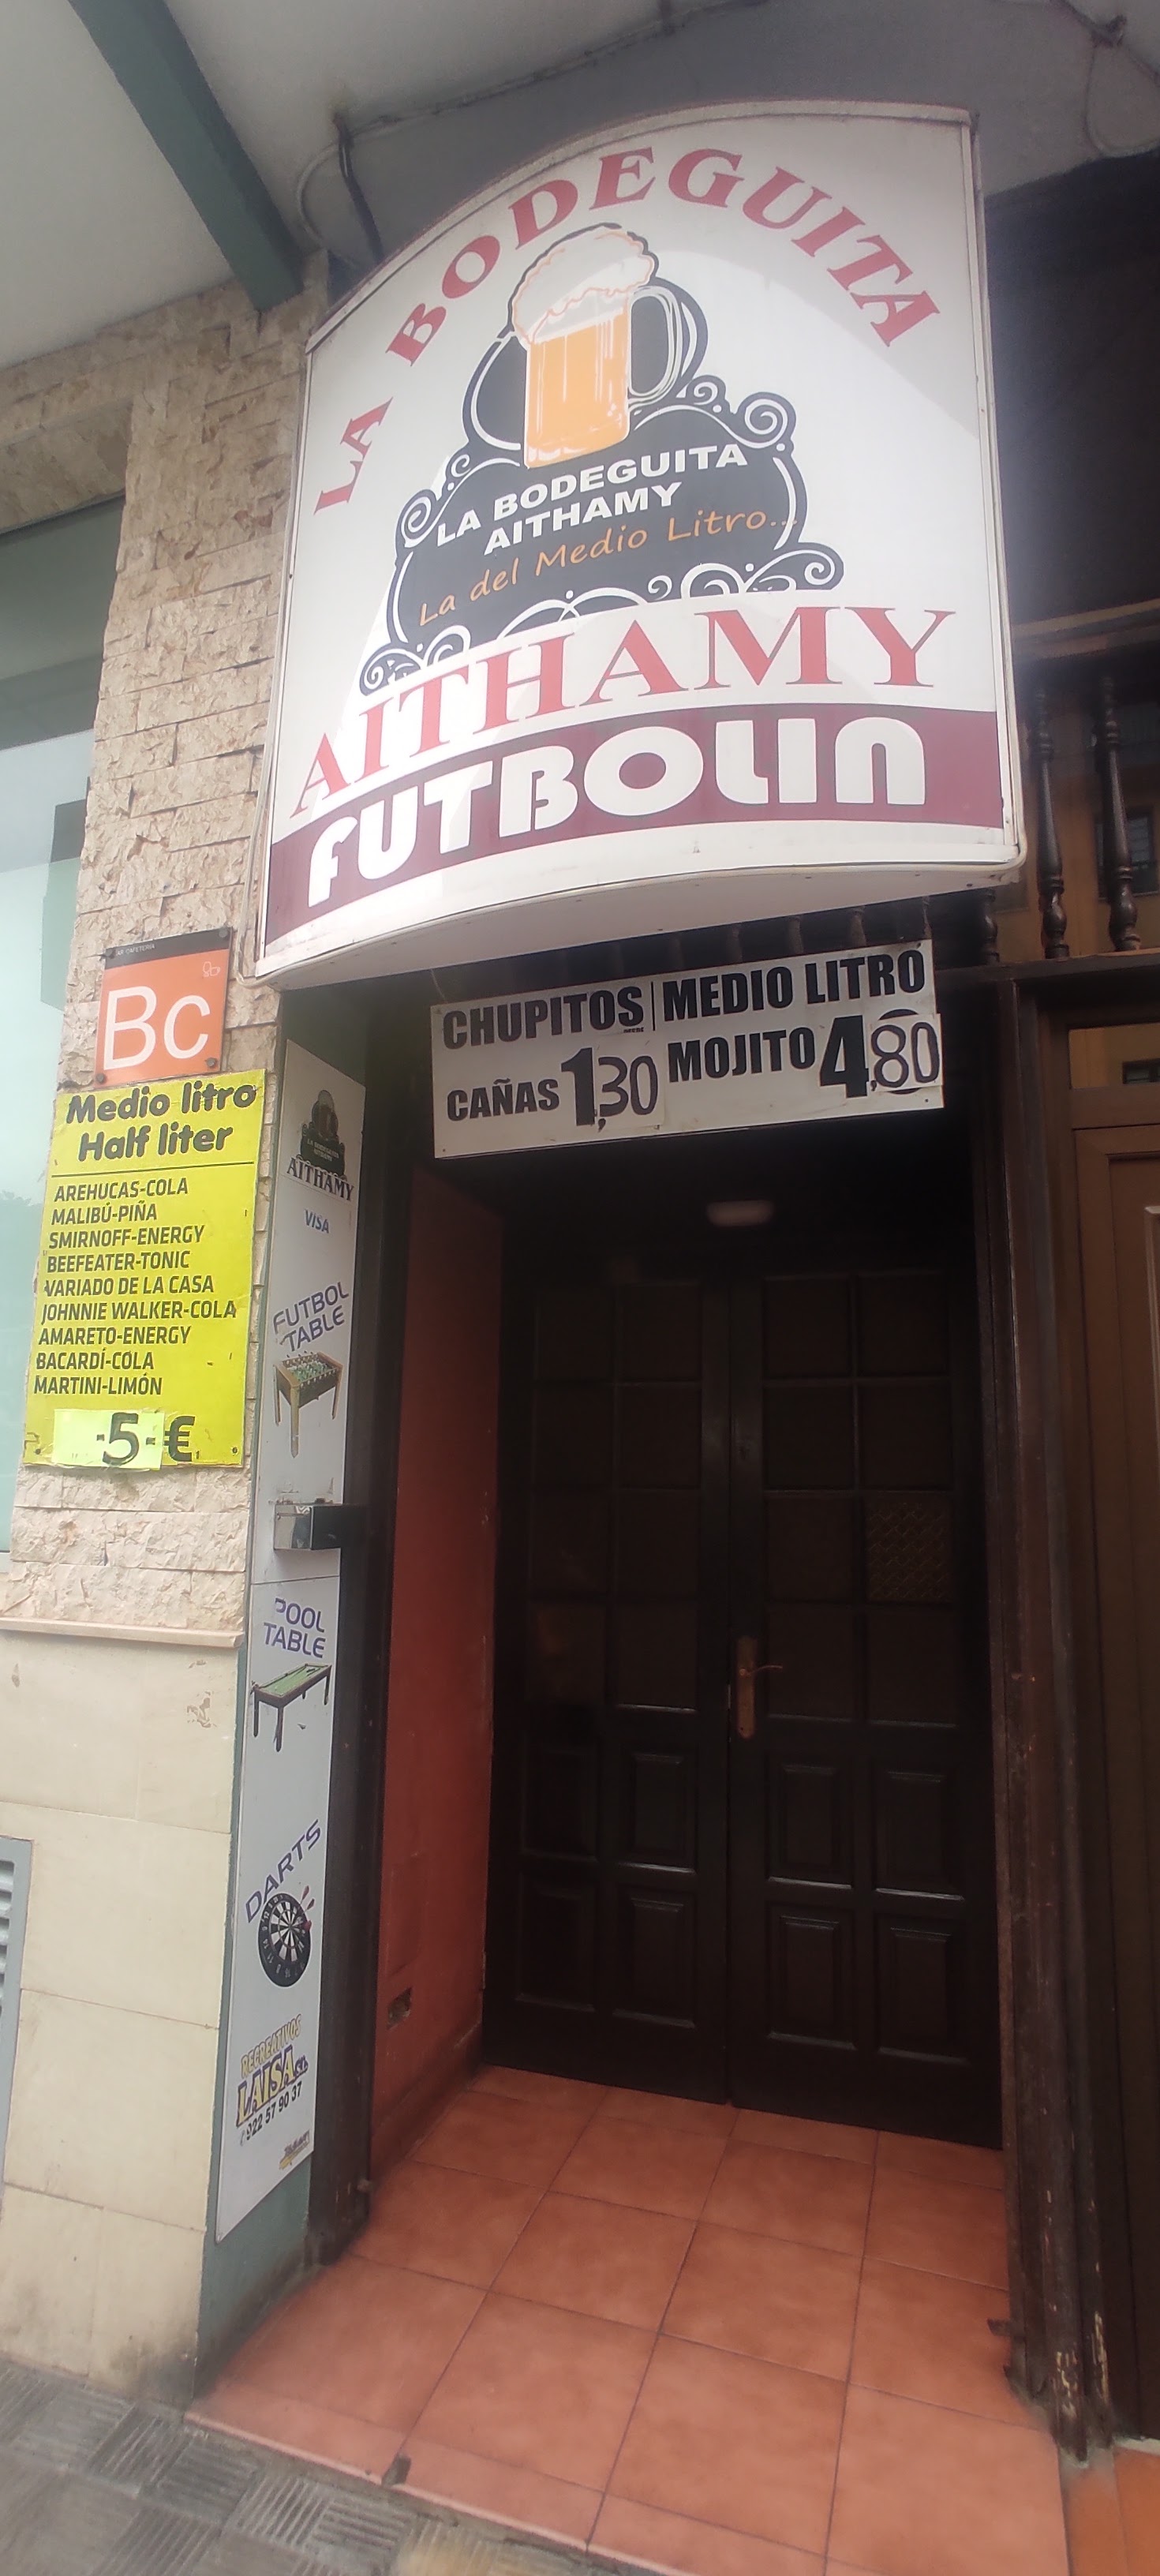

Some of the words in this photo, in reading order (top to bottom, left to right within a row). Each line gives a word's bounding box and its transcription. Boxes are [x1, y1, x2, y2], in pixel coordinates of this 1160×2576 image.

[314, 396, 393, 515] LA
[385, 145, 940, 366] BODEGUITA
[437, 509, 481, 546] LA
[494, 444, 747, 522] BODEGUITA
[484, 481, 682, 556] AITHAMY
[419, 593, 455, 627] La
[470, 557, 519, 602] del
[534, 526, 648, 577] Medio
[290, 606, 956, 819] AITHAMY
[308, 716, 926, 909] FUTBOLIN
[664, 966, 793, 1021] MEDIO
[804, 949, 925, 1005] LITRO
[103, 986, 211, 1071] Bc
[442, 986, 645, 1050] CHUPITOS
[668, 1027, 816, 1083] MOJITO
[820, 1015, 940, 1098] 4,80
[66, 1086, 170, 1124] Medio
[181, 1080, 257, 1114] litro
[447, 1077, 560, 1121] CAÑAS
[561, 1047, 658, 1133] 1,30
[78, 1125, 152, 1161] Half
[158, 1121, 233, 1155] liter
[54, 1178, 189, 1202] AREHUCAS-COLA
[286, 1157, 355, 1202] AITHAMY
[48, 1225, 205, 1249] SMIRNOFF-ENERGY
[51, 1200, 158, 1225] MALIBÚ-PIÑA
[305, 1209, 330, 1234] VISA
[44, 1279, 114, 1297] VARIADO
[118, 1277, 139, 1294] DE
[143, 1276, 164, 1294] LA
[169, 1275, 214, 1294] CASA
[47, 1250, 191, 1273] BEEFEATER-TONIC
[41, 1302, 107, 1324] JOHNNIE
[111, 1300, 237, 1320] WALKER-COLA
[273, 1282, 349, 1334] FUTBOL
[279, 1305, 346, 1352] TABLE
[36, 1347, 154, 1370] BACARDÍ-COLA
[39, 1326, 191, 1345] AMARETO-ENERGY
[34, 1372, 163, 1395] MARTINI-LIMÓN
[275, 1597, 325, 1633] POOL
[264, 1622, 326, 1659] TABLE
[245, 1818, 321, 1923] DARTS
[241, 2014, 301, 2079] RECREATIVOS
[237, 2044, 296, 2127] LAISA
[246, 2113, 263, 2141] 922
[265, 2102, 276, 2125] 57
[279, 2092, 290, 2113] 90
[291, 2081, 302, 2102] 37
